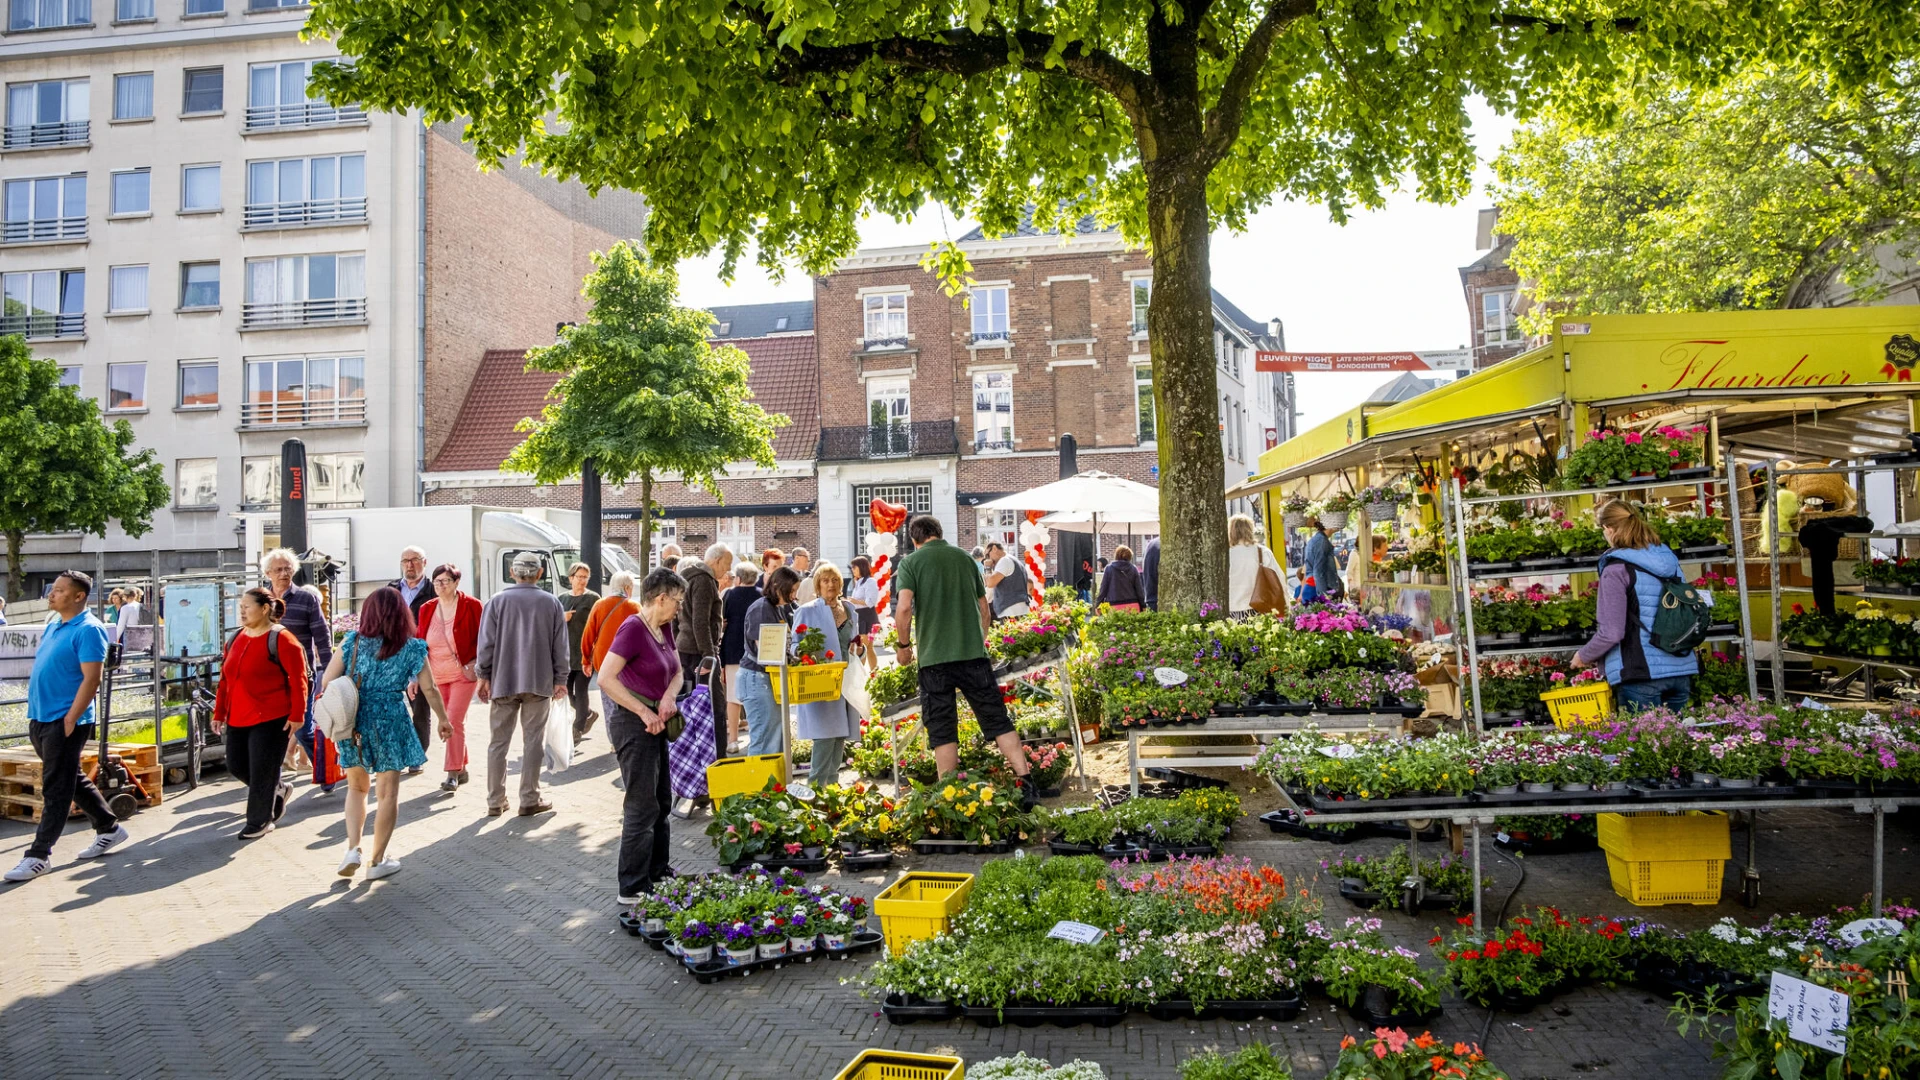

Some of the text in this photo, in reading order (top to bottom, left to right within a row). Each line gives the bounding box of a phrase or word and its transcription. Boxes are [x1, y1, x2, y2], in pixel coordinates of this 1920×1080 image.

[1259, 354, 1291, 362] LEUVEN
[1304, 355, 1333, 363] NIGHT
[1642, 340, 1852, 389] Fleurdecor
[1889, 343, 1917, 361] Quality
[289, 466, 302, 499] Duvel
